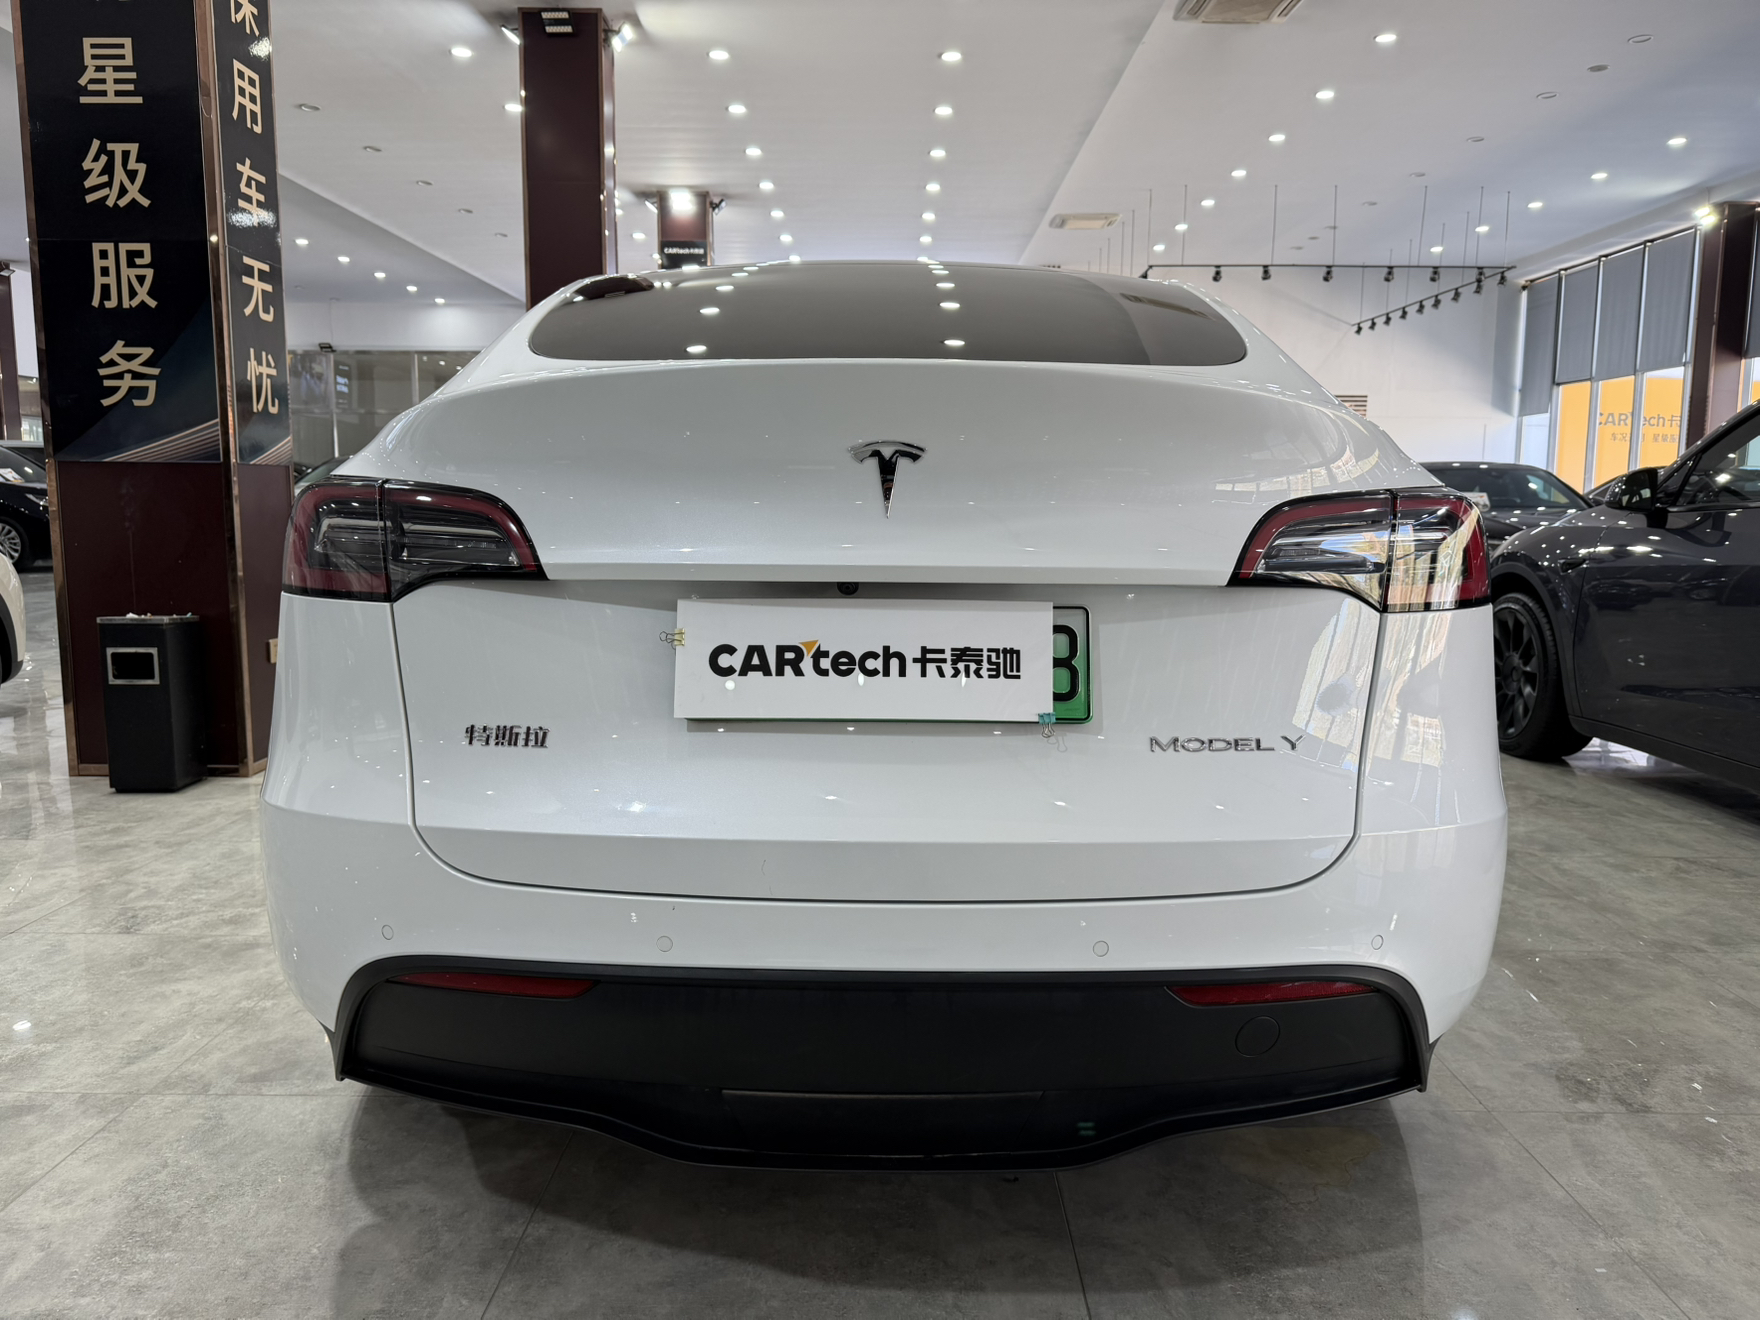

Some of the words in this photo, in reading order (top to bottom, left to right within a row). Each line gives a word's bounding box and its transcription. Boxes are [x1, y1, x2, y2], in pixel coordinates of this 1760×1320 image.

[77, 36, 161, 407] 星级服务
[708, 640, 907, 678] CARtech
[913, 645, 1021, 680] 卡泰驰
[465, 724, 550, 749] 特斯拉
[1150, 736, 1275, 752] MODEL
[1281, 734, 1306, 751] Y
